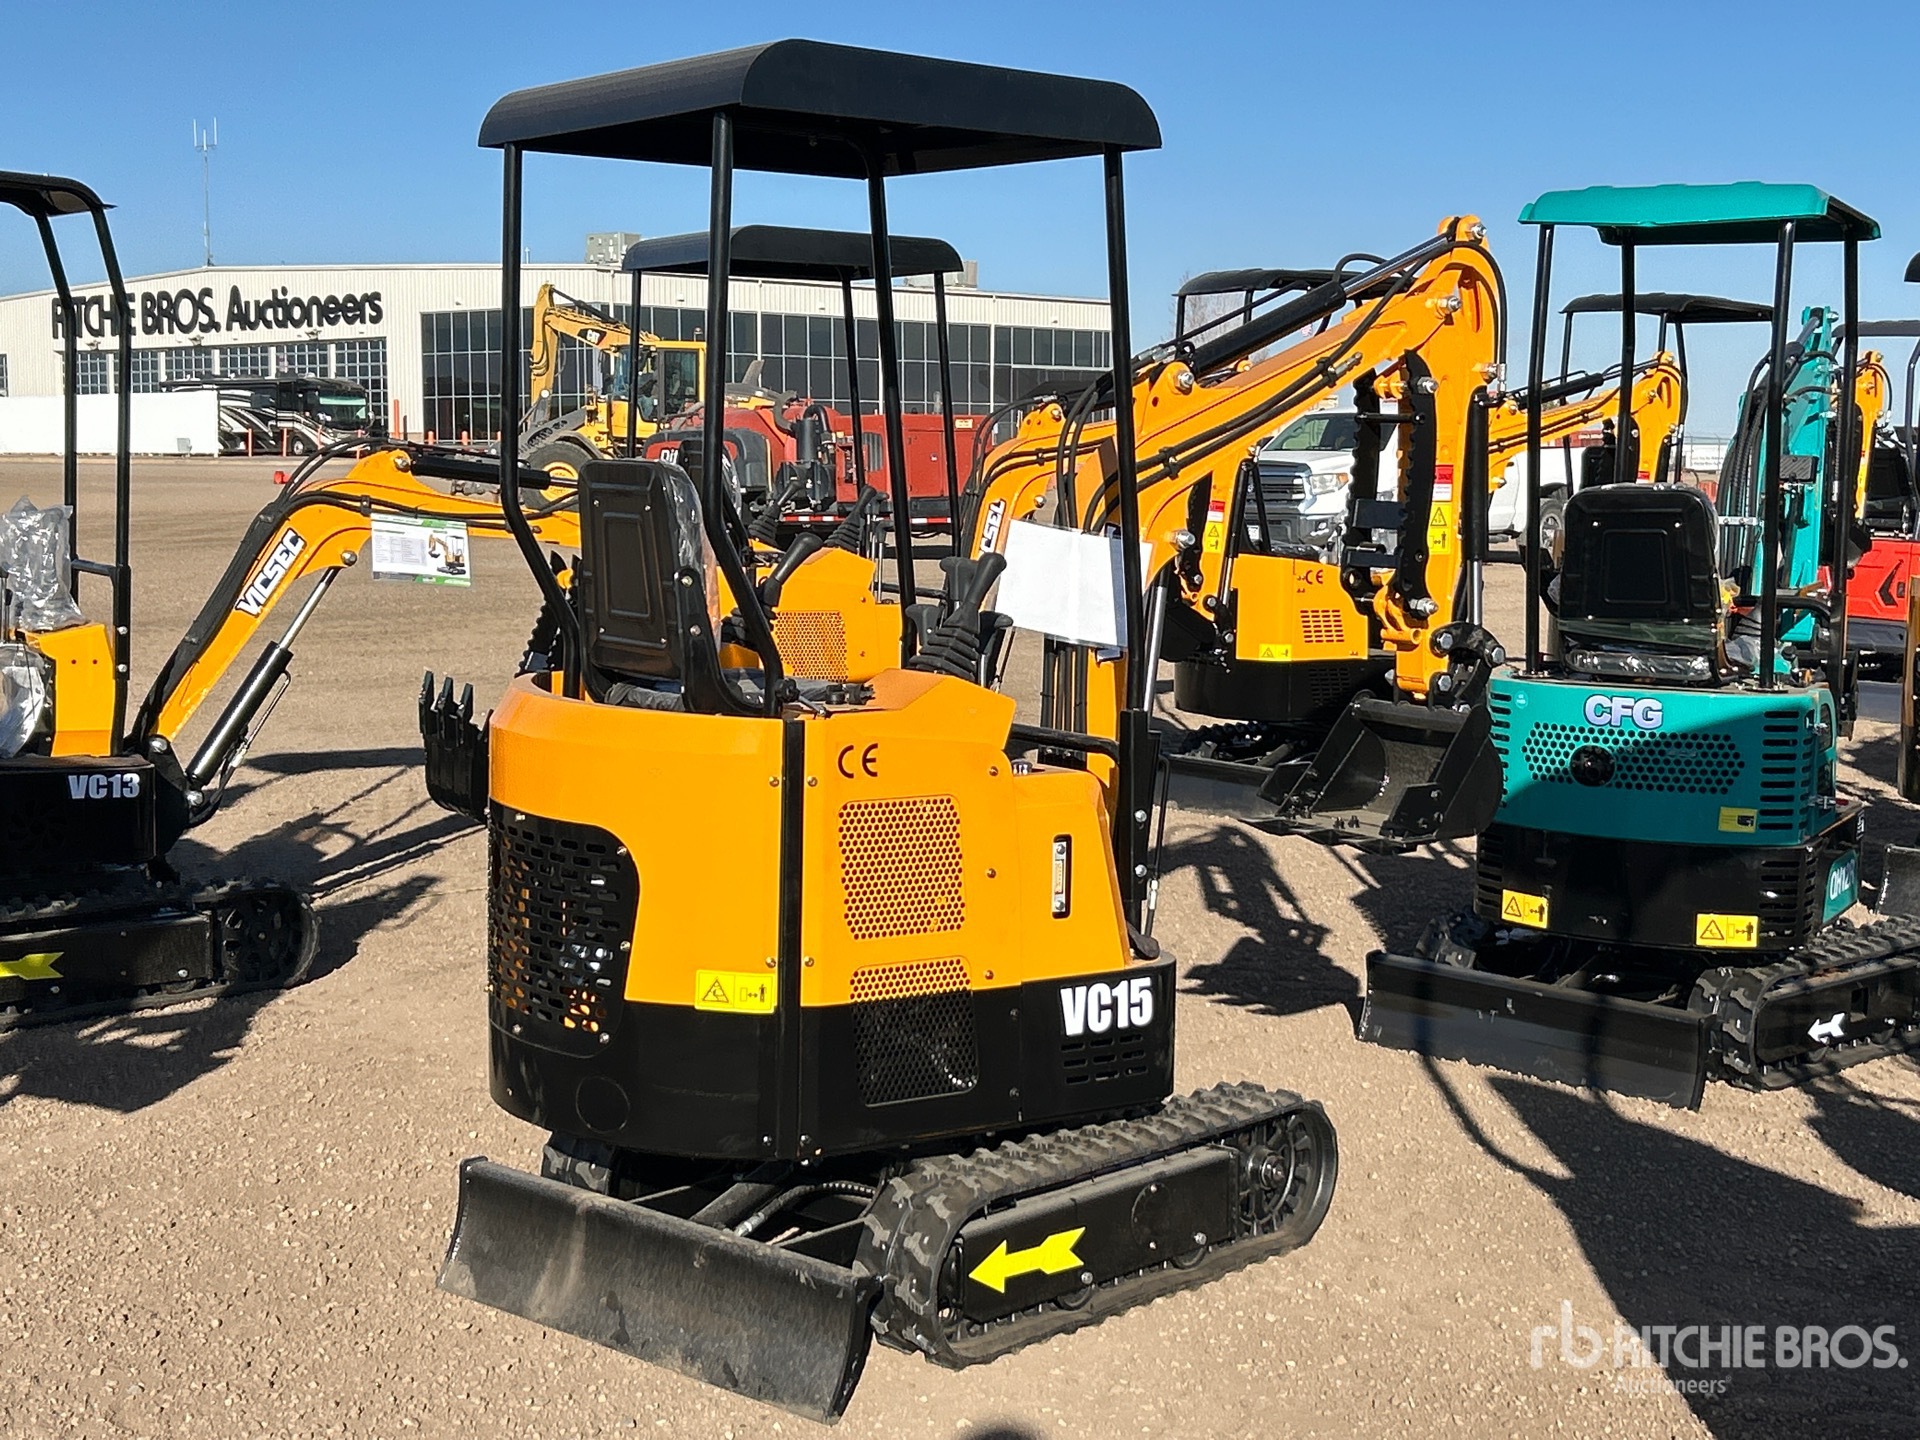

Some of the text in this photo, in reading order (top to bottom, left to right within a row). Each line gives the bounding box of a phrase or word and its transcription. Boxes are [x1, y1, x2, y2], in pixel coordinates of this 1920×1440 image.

[141, 287, 221, 335] BROS.
[226, 285, 383, 331] Auctioneers
[236, 528, 306, 616] VICSEC
[1584, 694, 1663, 729] CFG
[837, 743, 878, 779] CE
[67, 773, 140, 799] VC13
[1060, 976, 1153, 1036] VC15
